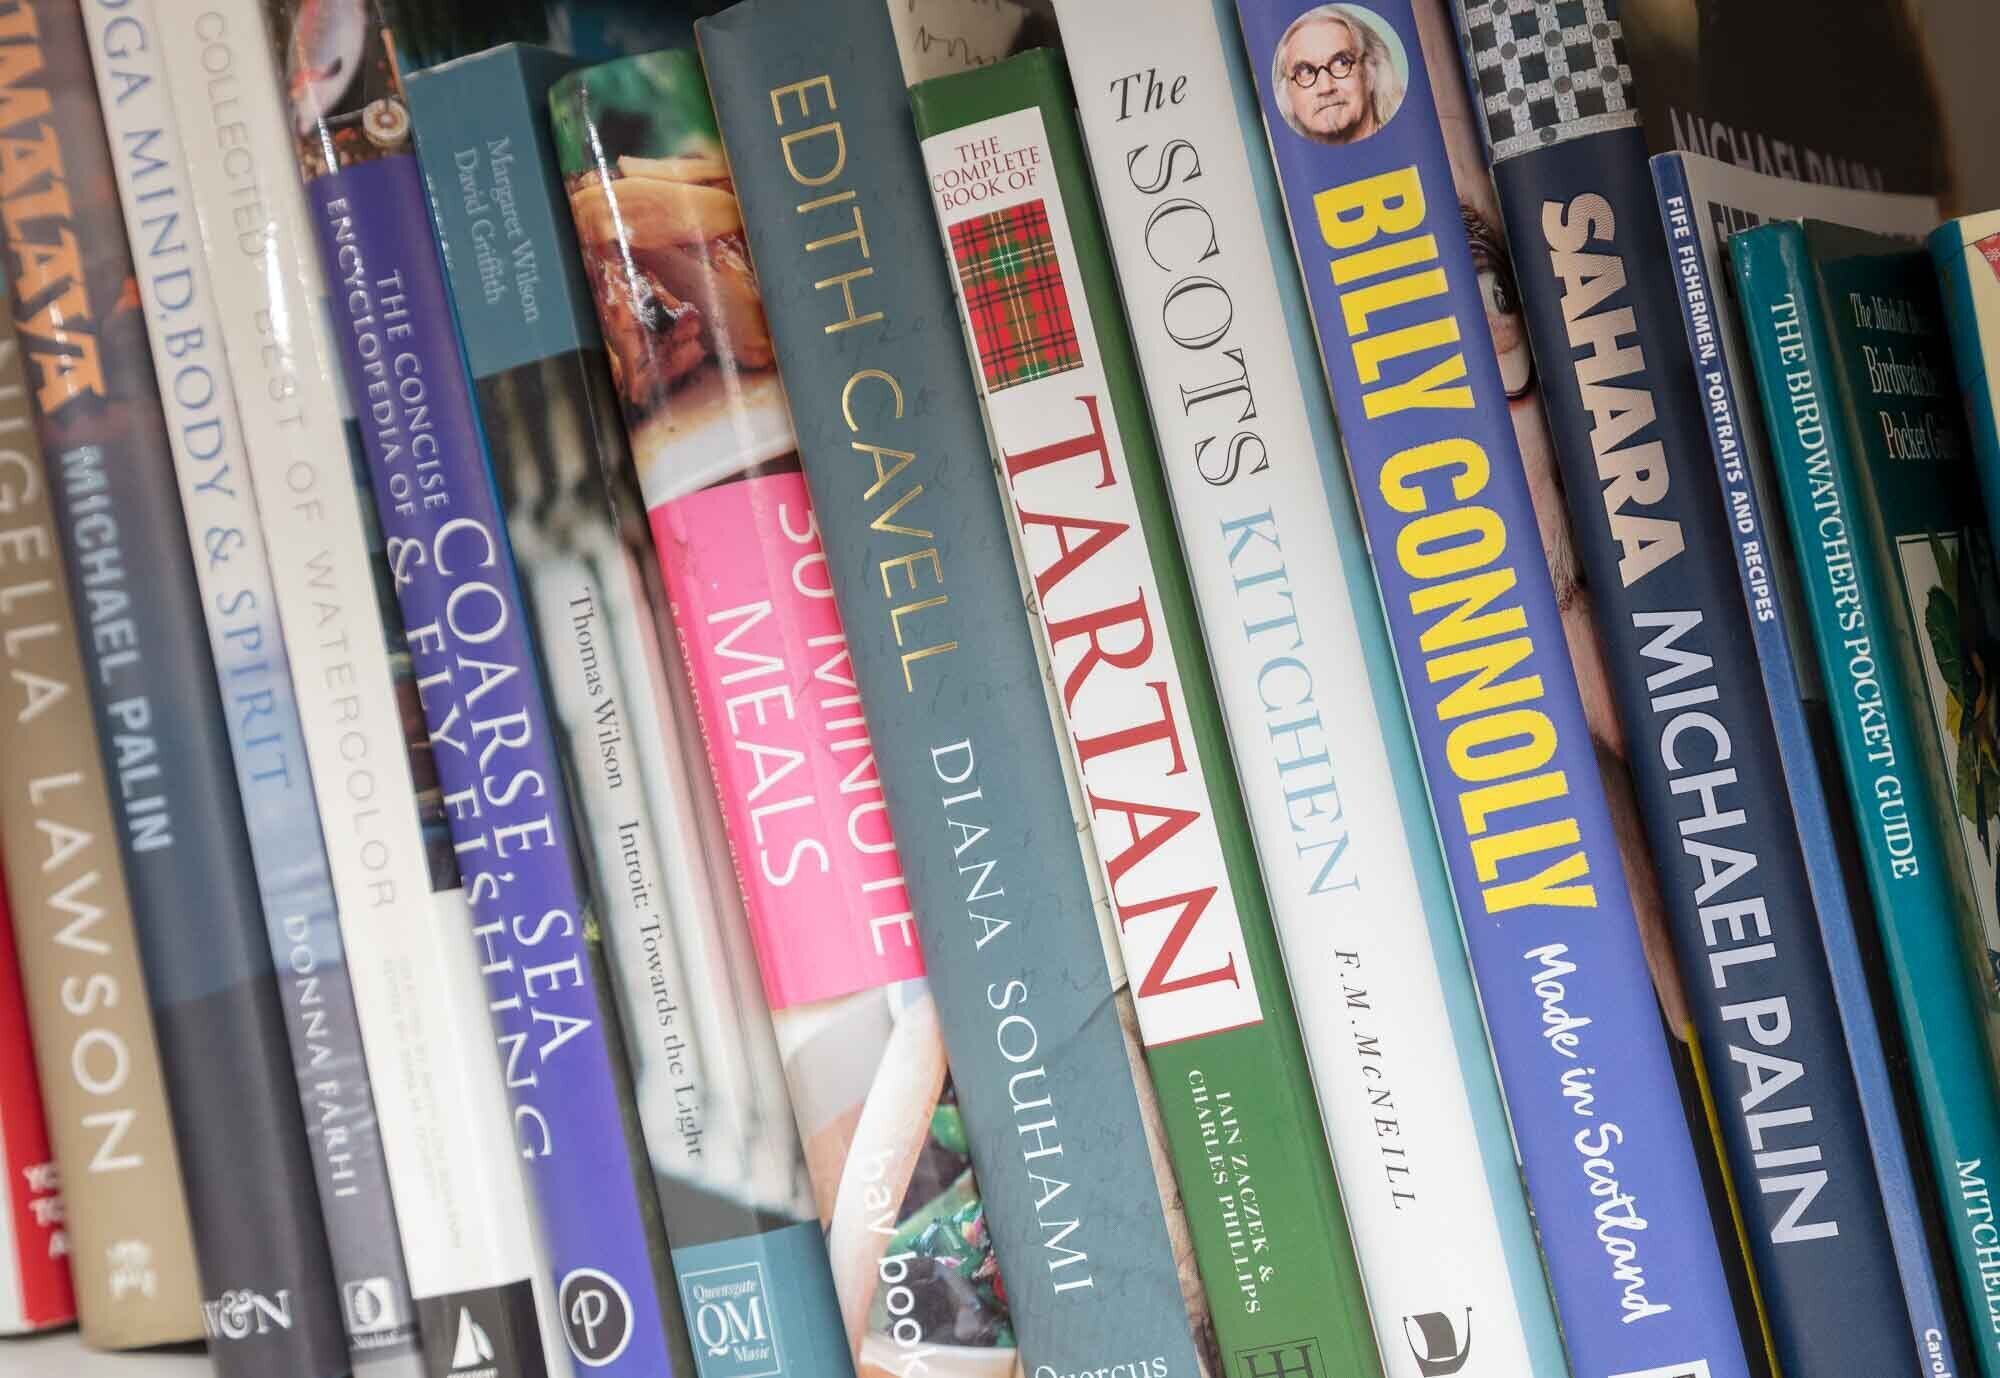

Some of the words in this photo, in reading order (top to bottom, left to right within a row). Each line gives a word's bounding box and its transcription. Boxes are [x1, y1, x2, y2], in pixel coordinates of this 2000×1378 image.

[194, 10, 267, 259] COLLECTED
[955, 136, 1001, 165] THE
[1109, 68, 1188, 123] The
[454, 149, 484, 220] David
[472, 219, 508, 305] Griffith
[486, 137, 524, 241] Margaret
[510, 241, 541, 324] Wilson
[933, 146, 1042, 194] COMPLETE
[942, 180, 1006, 212] BOOK
[1007, 168, 1039, 191] OF
[1667, 196, 1689, 239] FIFE
[326, 197, 403, 463] ENCYCLOPEDIA
[388, 471, 416, 517] OF
[377, 268, 411, 343] THE
[1312, 165, 1477, 421] BILLY
[1678, 245, 1717, 366] FISHERMEN,
[1771, 293, 1807, 367] THE
[393, 352, 450, 509] CONCISE
[769, 73, 885, 335] EDITH
[841, 368, 959, 694] CAVELL
[1705, 371, 1745, 484] PORTRAITS
[204, 526, 246, 572] &
[286, 460, 325, 521] OF
[1126, 138, 1271, 488] SCOTS
[1219, 504, 1361, 897] KITCHEN
[1731, 489, 1755, 535] AND
[1786, 369, 1868, 634] BIRDWATCHER'S
[386, 536, 427, 587] &
[1742, 541, 1776, 624] RECIPES
[62, 444, 140, 686] MICHAEL
[108, 696, 174, 854] PALIN
[216, 588, 292, 790] SPIRIT
[406, 616, 468, 756] FLY
[568, 587, 604, 697] Thomas
[1001, 394, 1241, 1000] TARTAN
[1378, 437, 1599, 915] CONNOLLY
[1844, 637, 1896, 769] POCKET
[304, 550, 397, 908] WATERCOLOR
[592, 697, 623, 791] Wilson
[707, 600, 831, 888] MEALS
[1540, 192, 1686, 590] SAHARA
[1631, 608, 1777, 990] MICHAEL
[1720, 996, 1840, 1245] PALIN
[617, 819, 649, 909] Introit:
[806, 634, 918, 958] MINUTE
[1872, 773, 1921, 881] GUIDE
[29, 772, 145, 1174] LAWSON
[443, 786, 553, 1161] FISHING
[512, 909, 592, 1062] SEA
[638, 913, 680, 1028] Towards
[930, 737, 1013, 951] DIANA
[986, 979, 1095, 1296] SOUHAMI
[1523, 943, 1594, 1059] Made
[284, 914, 334, 1068] DONNA
[318, 1079, 359, 1198] FARHI
[662, 1032, 686, 1077] the
[673, 1083, 706, 1159] Light
[1560, 1066, 1597, 1117] in
[1187, 1069, 1230, 1186] CHARLES
[1217, 1195, 1263, 1315] PHILLIPS
[1215, 1091, 1244, 1145] IAIN
[1230, 1151, 1271, 1256] ZACZEK
[1258, 1264, 1275, 1283] &
[1573, 1121, 1673, 1326] Scotland
[696, 1296, 768, 1357] QM
[733, 1345, 771, 1363] Music
